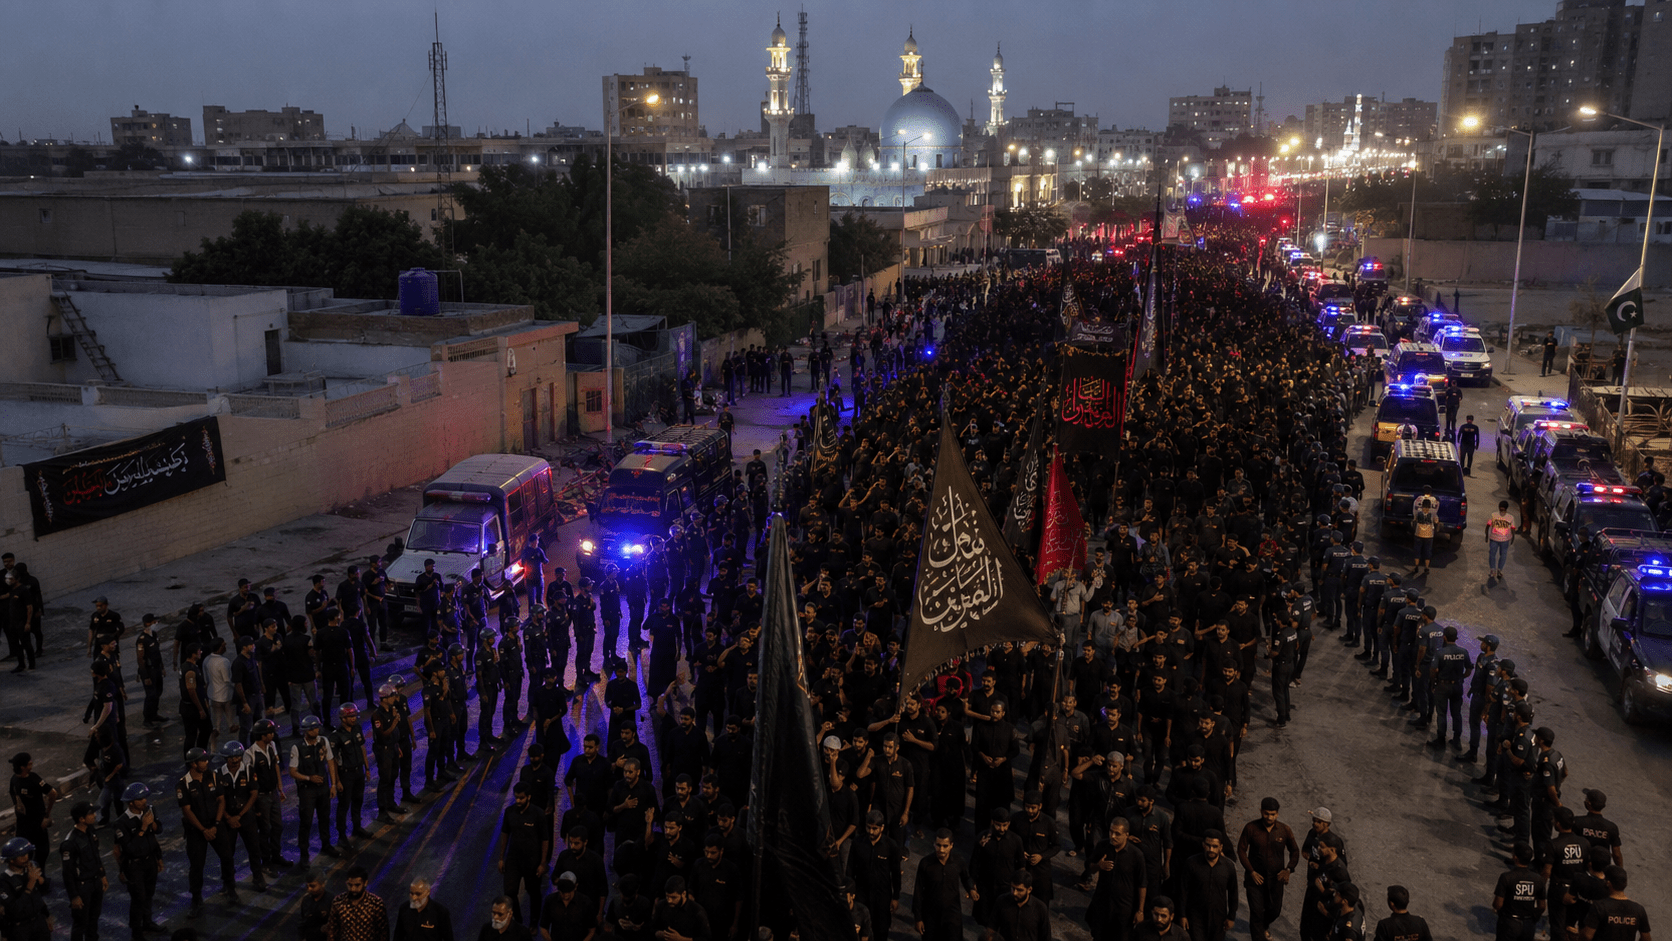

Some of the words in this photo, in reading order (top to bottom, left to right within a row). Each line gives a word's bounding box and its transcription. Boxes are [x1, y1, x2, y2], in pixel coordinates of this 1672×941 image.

[1564, 845, 1582, 859] SPU
[1515, 883, 1534, 896] SPU
[1608, 915, 1636, 926] POLICE
